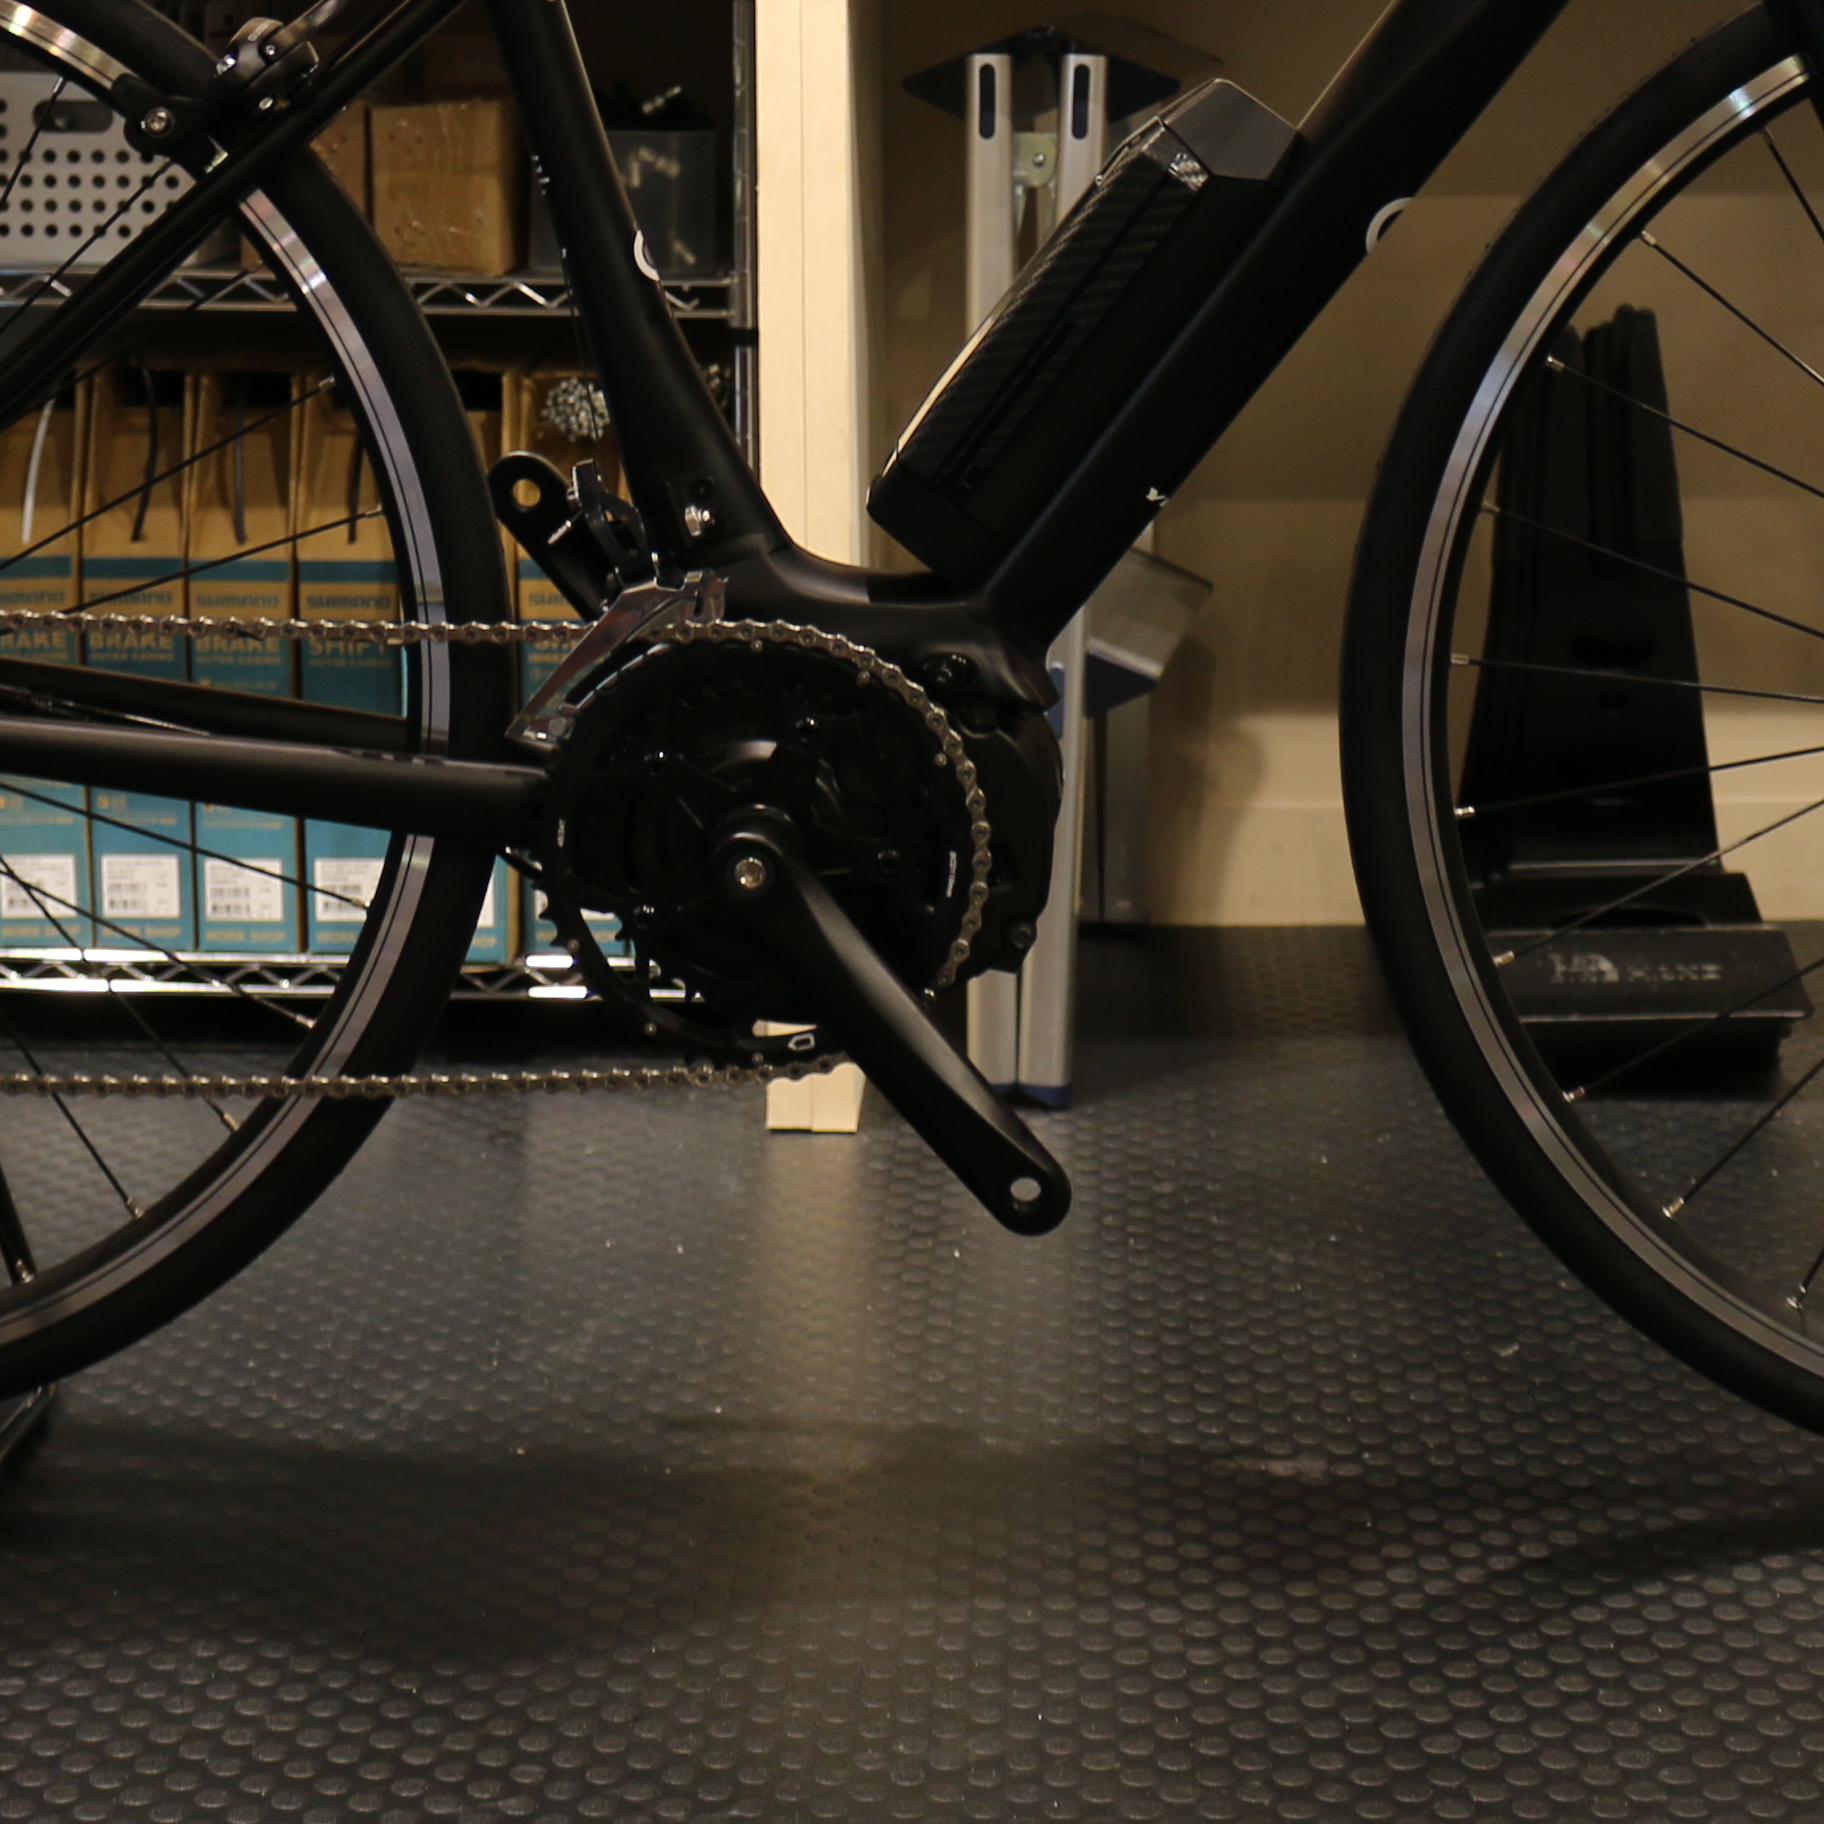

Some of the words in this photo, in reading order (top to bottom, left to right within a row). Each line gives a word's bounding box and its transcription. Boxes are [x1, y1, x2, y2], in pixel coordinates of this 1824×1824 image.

[196, 595, 280, 607] SHIMANO
[307, 595, 392, 609] SHIMANO
[89, 630, 173, 650] BRAKE
